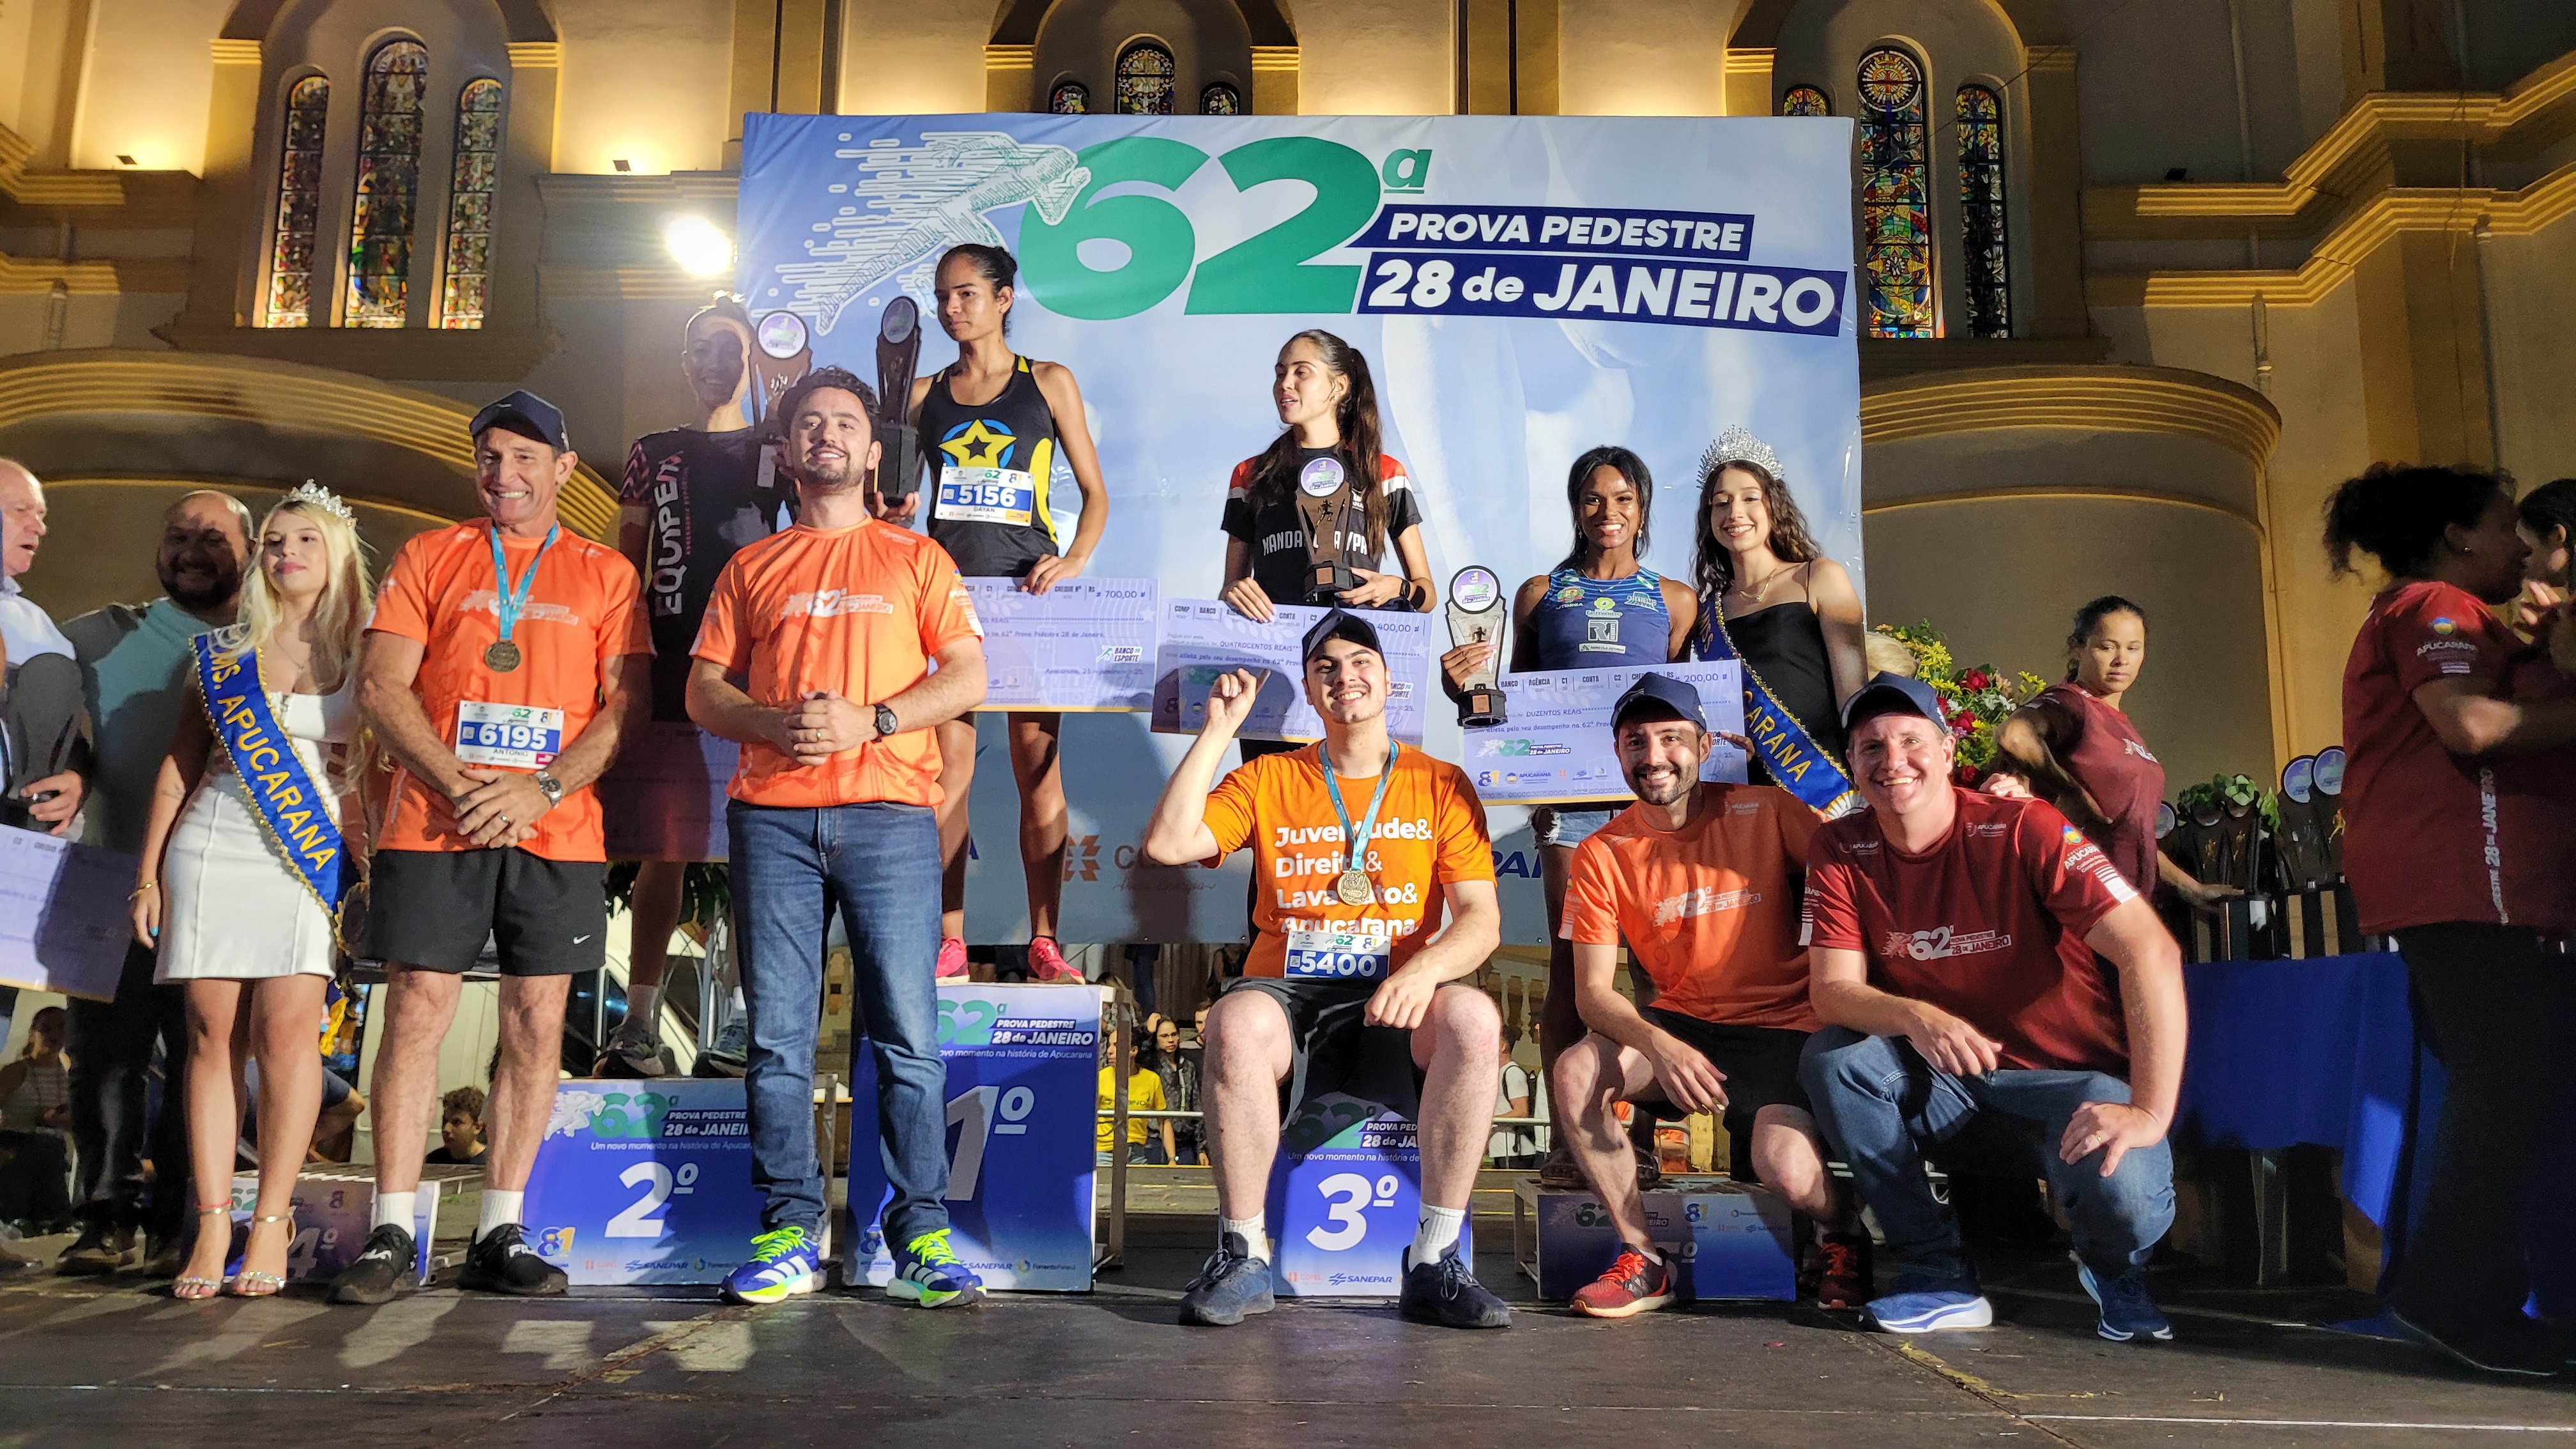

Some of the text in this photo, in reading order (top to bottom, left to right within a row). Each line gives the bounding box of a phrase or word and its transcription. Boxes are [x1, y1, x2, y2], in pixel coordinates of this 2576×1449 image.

[1020, 135, 1432, 320] 62ª
[1388, 213, 1744, 252] PROVA PEDESTRE
[1368, 259, 1836, 327] 28 de JANEIRO
[958, 484, 1016, 507] 5156
[1105, 590, 1137, 600] 700,00
[1377, 623, 1411, 633] 400,00
[1220, 640, 1272, 650] QUATROCENTOS
[1528, 677, 1551, 686] AGÊNCIA
[1683, 673, 1719, 683] 200,00
[1526, 709, 1561, 717] DUZENTOS
[1533, 723, 1570, 732] desempenho
[479, 723, 548, 751] 6195
[1744, 690, 1812, 783] CARANA
[217, 694, 338, 871] APUCARANA
[1477, 770, 1500, 787] 81
[2484, 845, 2501, 867] 28
[1275, 850, 1383, 878] Direit&
[1706, 903, 1716, 912] 28
[1966, 931, 1994, 941] PEDESTRE
[1952, 946, 1962, 955] 28
[1970, 937, 2010, 953] JANEIRO
[1299, 951, 1377, 977] 5400
[996, 1019, 1075, 1029] PROVA PEDESTRE
[992, 1031, 1094, 1045] 28 de JANEIRO
[939, 1049, 955, 1057] ovo
[1007, 1049, 1037, 1058] história
[1038, 1050, 1048, 1059] de
[1050, 1050, 1092, 1059] Apucarana
[669, 1110, 747, 1120] PROVA PEDESTRE
[664, 1122, 749, 1137] 28 de JANEI
[1366, 1123, 1398, 1131] PROVA
[590, 1141, 606, 1151] Um
[628, 1142, 667, 1151] momento
[679, 1140, 709, 1151] história
[710, 1141, 721, 1151] de
[721, 1141, 752, 1152] Apucar
[945, 1085, 1035, 1201] 1º
[1361, 1135, 1381, 1147] 28
[1383, 1137, 1397, 1146] de
[1288, 1152, 1302, 1160] Um
[1377, 1153, 1407, 1162] história
[1409, 1153, 1420, 1162] de
[604, 1161, 700, 1239] 2º
[1305, 1172, 1399, 1252] 3º
[1685, 1202, 1710, 1223] 81
[1648, 1218, 1669, 1227] EIRO
[537, 1227, 575, 1257] 81
[287, 1227, 339, 1279] 4º
[643, 1262, 688, 1270] SANEPAR
[968, 1262, 1013, 1270] SANEPAR
[1347, 1275, 1393, 1284] SANEPAR
